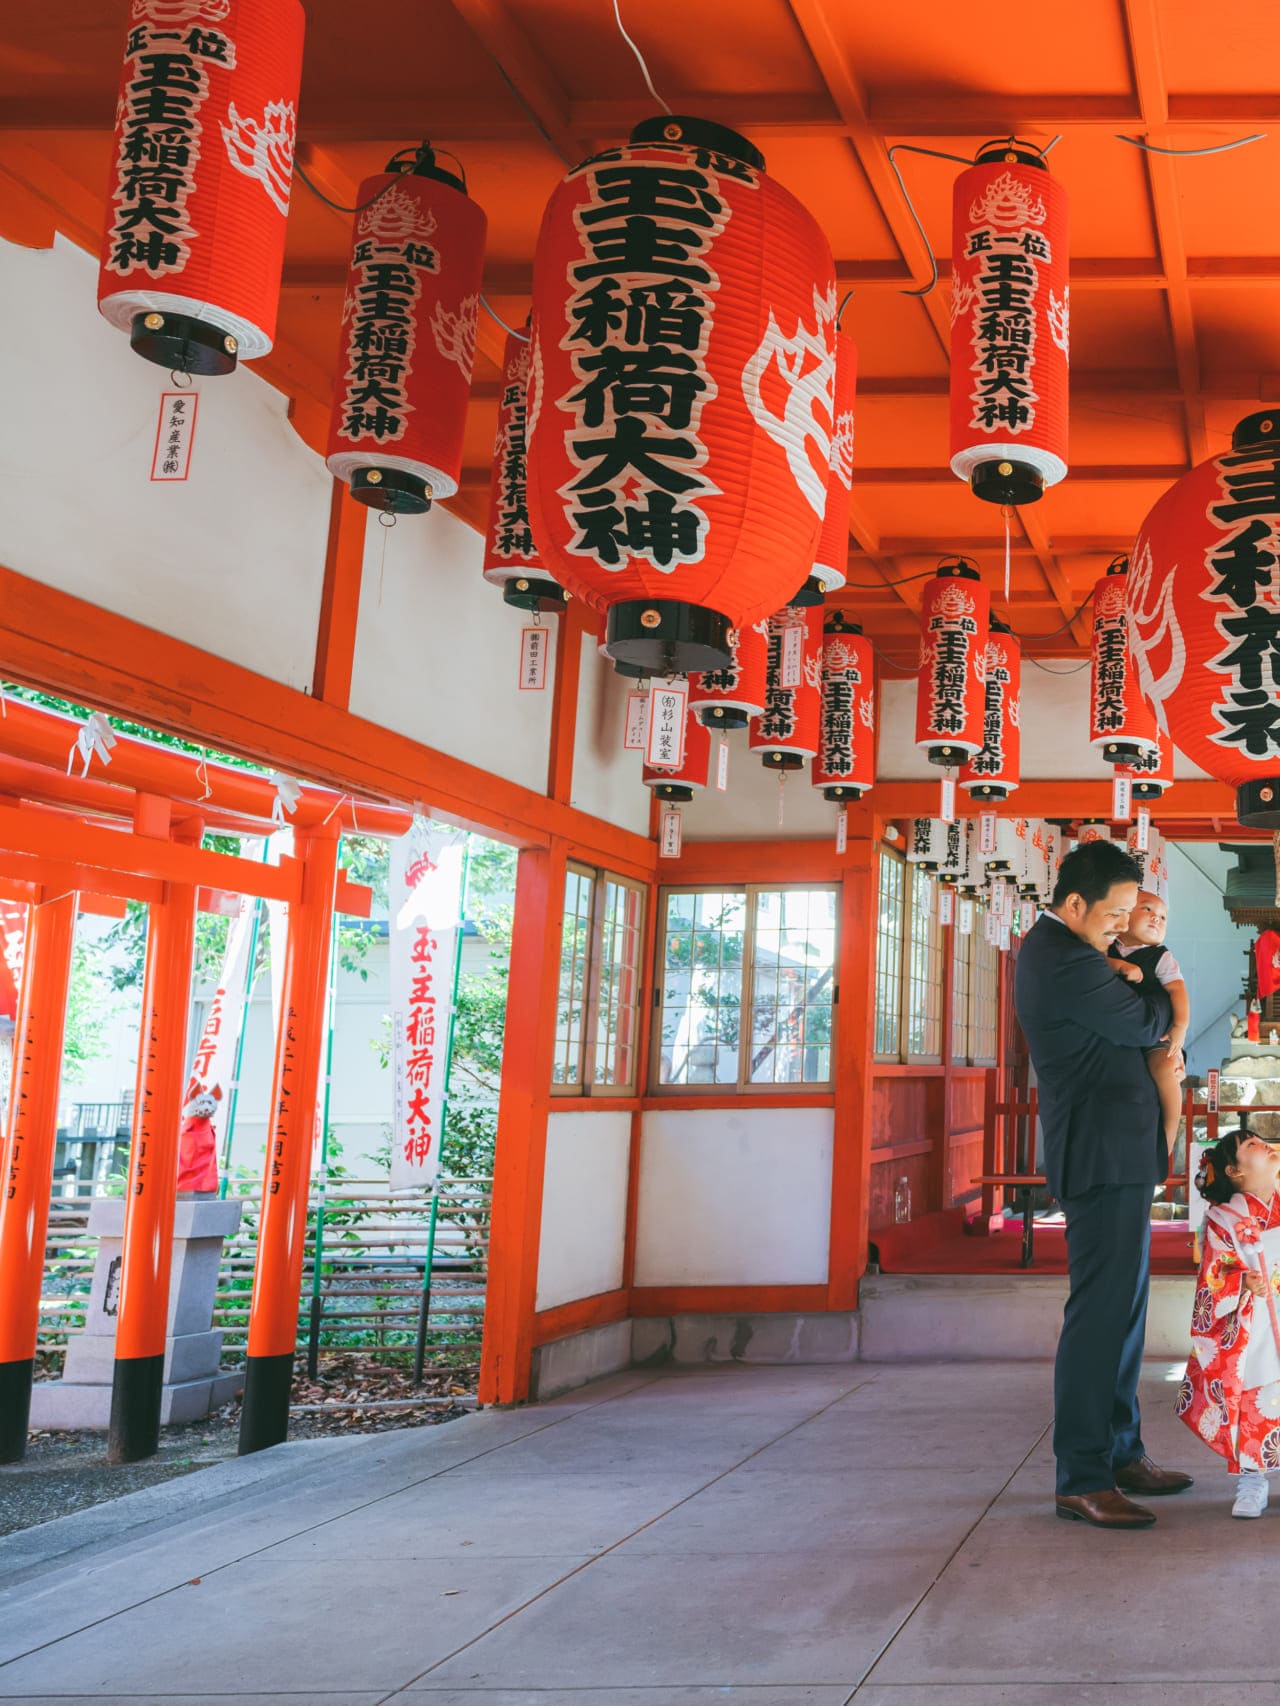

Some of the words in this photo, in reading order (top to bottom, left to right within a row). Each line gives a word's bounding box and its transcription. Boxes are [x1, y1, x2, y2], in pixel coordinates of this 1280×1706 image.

[126, 26, 227, 64] 正一位
[112, 53, 200, 270] 玉主稲荷大神
[354, 241, 434, 272] 正一位
[969, 231, 1046, 259] 正一位
[344, 264, 413, 438] 玉主稲荷大神
[567, 167, 724, 565] 玉主稲荷大神
[978, 254, 1033, 428] 玉主稲荷大神
[931, 618, 974, 632] 正一位
[824, 682, 851, 773] 玉主稲荷大神
[934, 629, 968, 731] 玉主稲荷大神
[1095, 628, 1125, 730] 玉主稲荷大神
[404, 927, 437, 1167] 玉主稲荷大神
